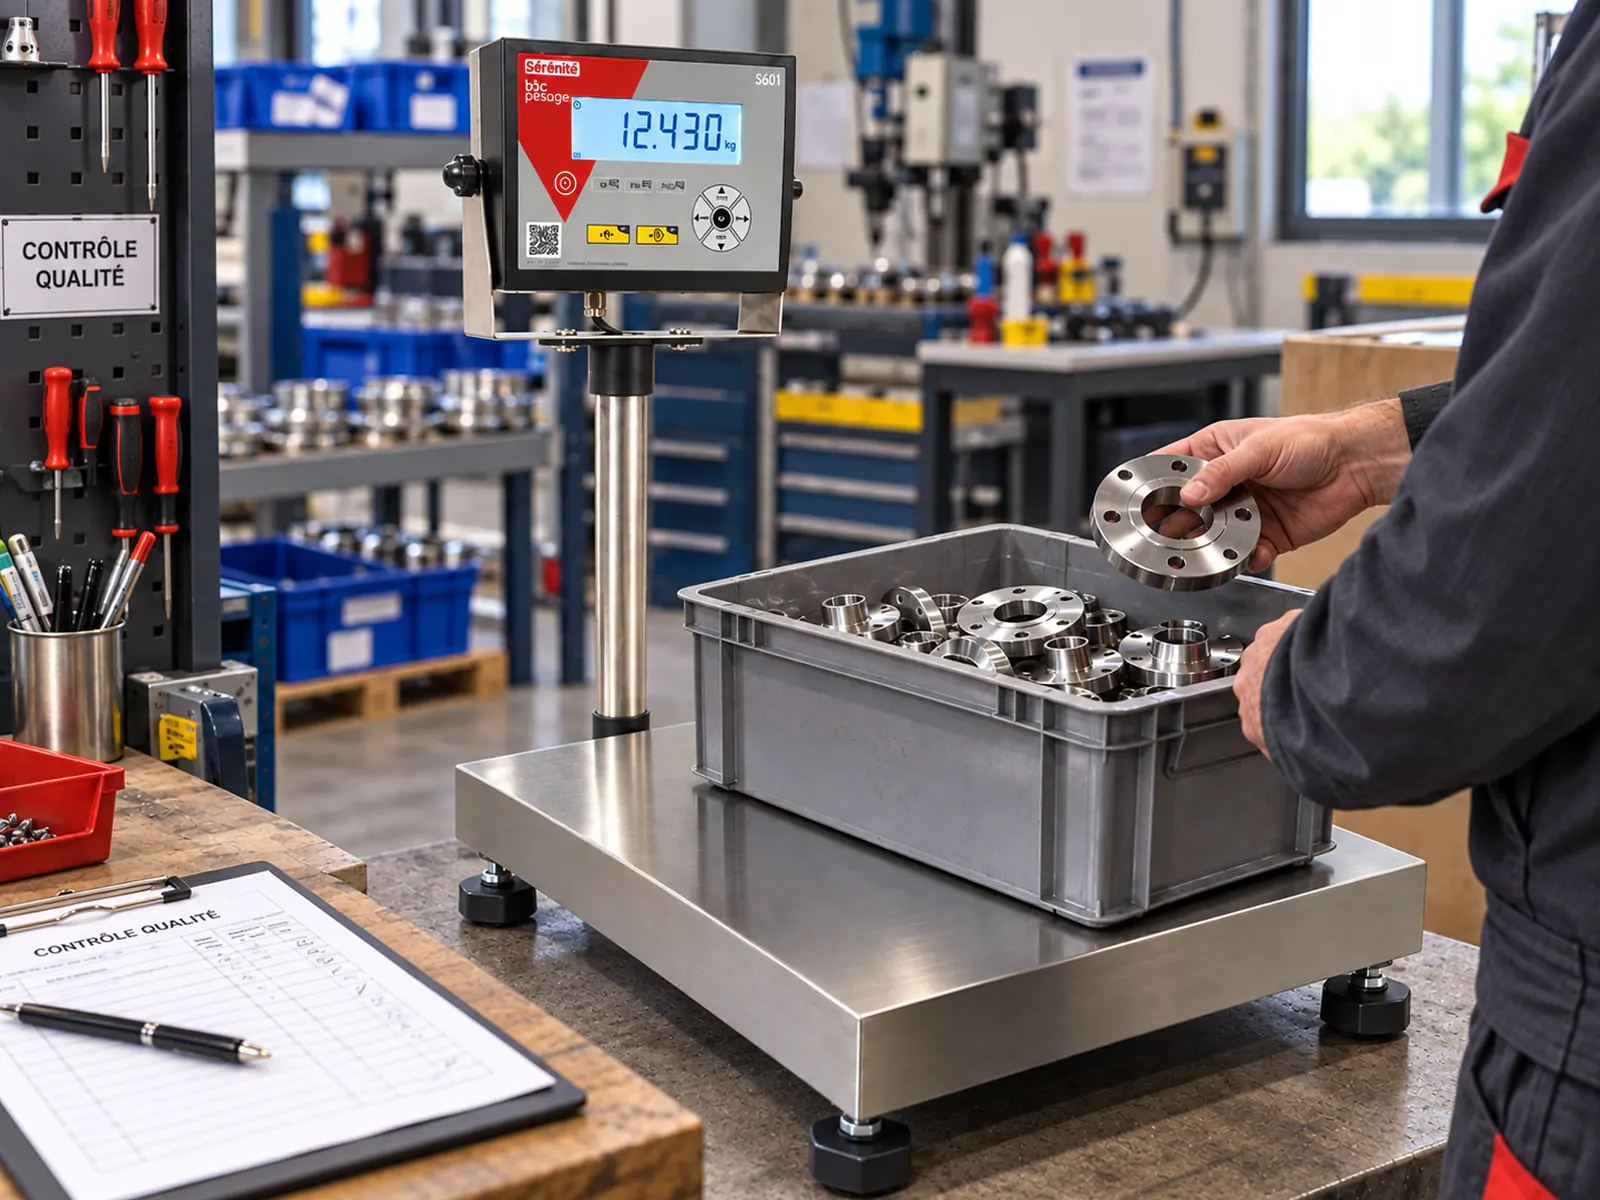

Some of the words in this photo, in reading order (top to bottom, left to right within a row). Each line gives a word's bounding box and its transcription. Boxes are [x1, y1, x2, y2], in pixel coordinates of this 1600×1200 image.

[526, 60, 578, 75] Sérénité
[755, 72, 781, 87] S601
[622, 110, 722, 151] 12.430
[724, 140, 737, 153] kg
[22, 235, 138, 260] CONTRÔLE
[36, 264, 125, 289] QUALITÉ
[33, 929, 139, 957] CONTRÔLE
[141, 909, 221, 935] QUALITÉ
